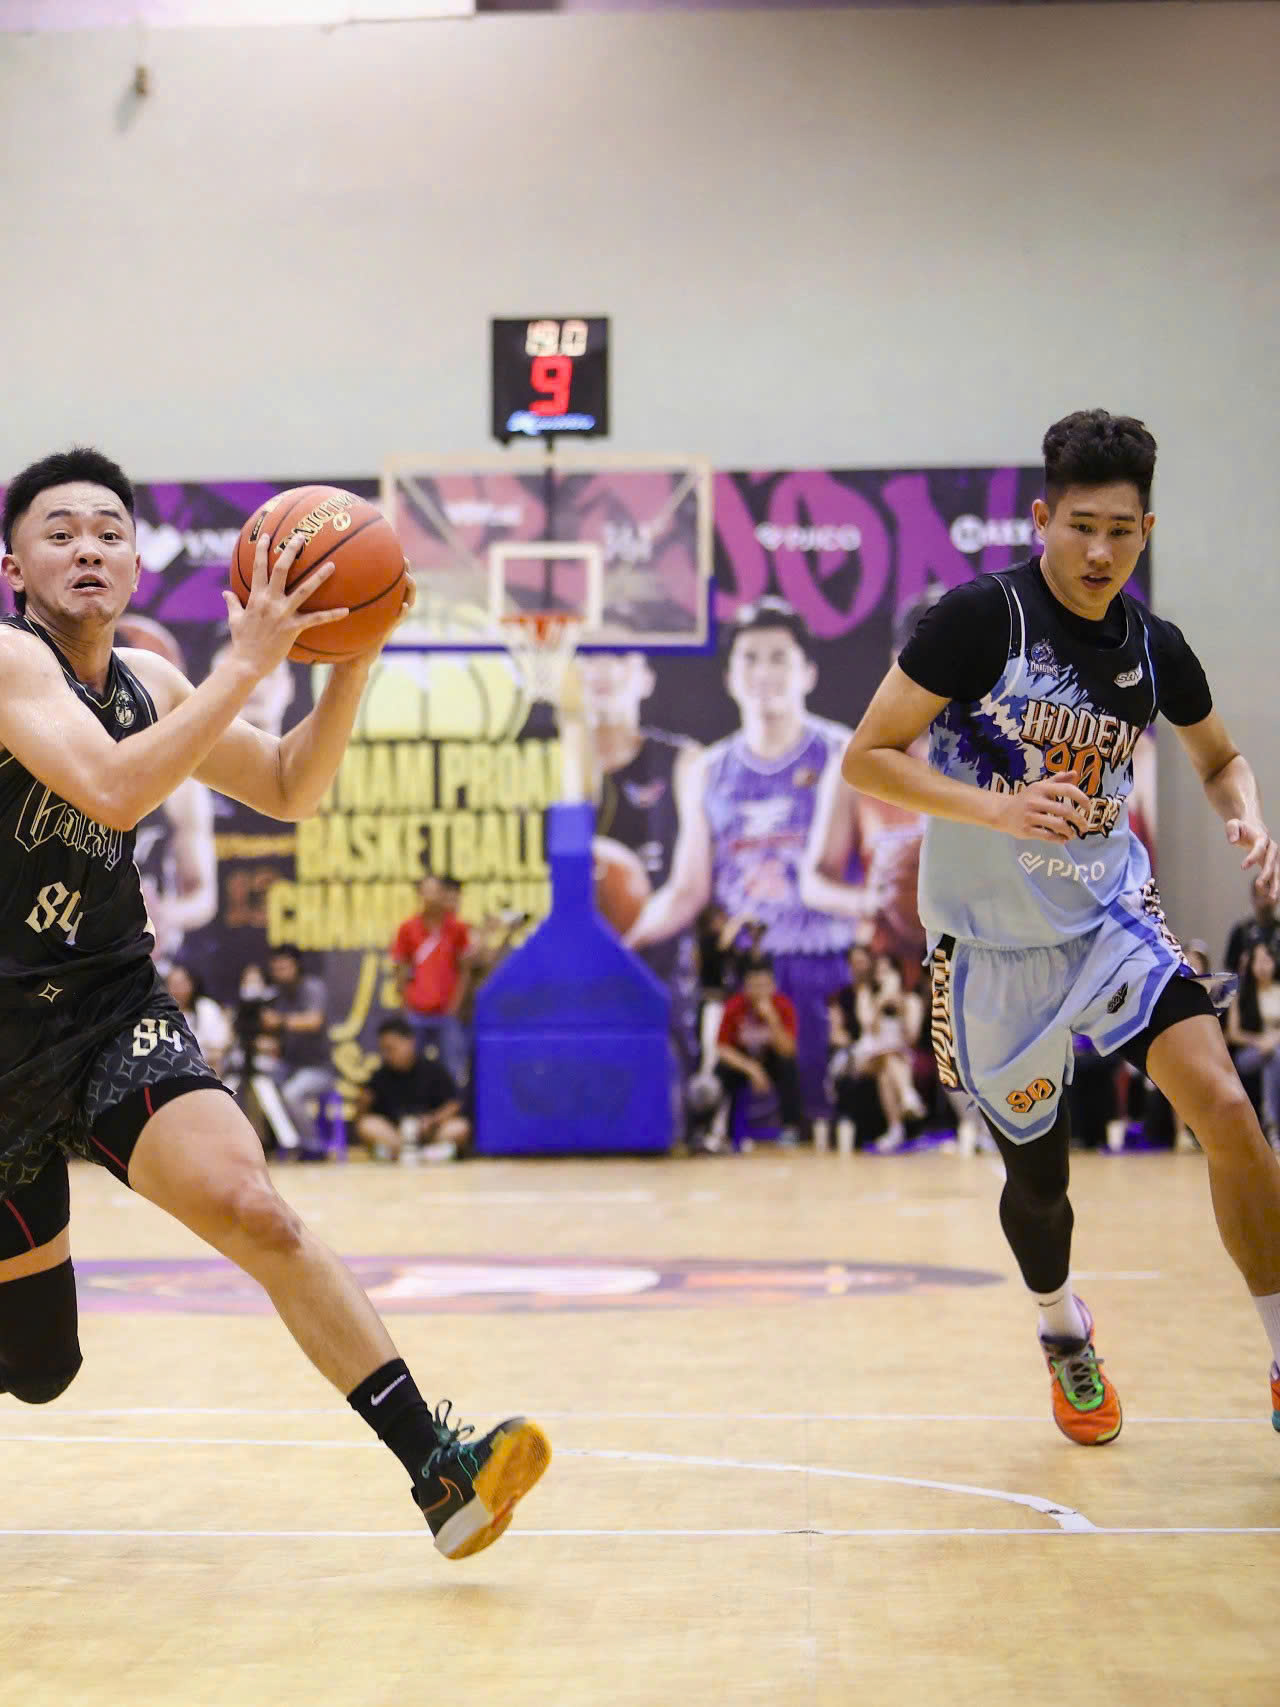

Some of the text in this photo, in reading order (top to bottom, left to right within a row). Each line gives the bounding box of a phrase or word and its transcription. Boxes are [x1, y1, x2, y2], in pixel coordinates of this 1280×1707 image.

[530, 355, 572, 416] 9
[298, 812, 552, 881] BASKETBALL
[25, 881, 85, 946] 84
[132, 1018, 184, 1058] 84
[1006, 1078, 1057, 1114] 90
